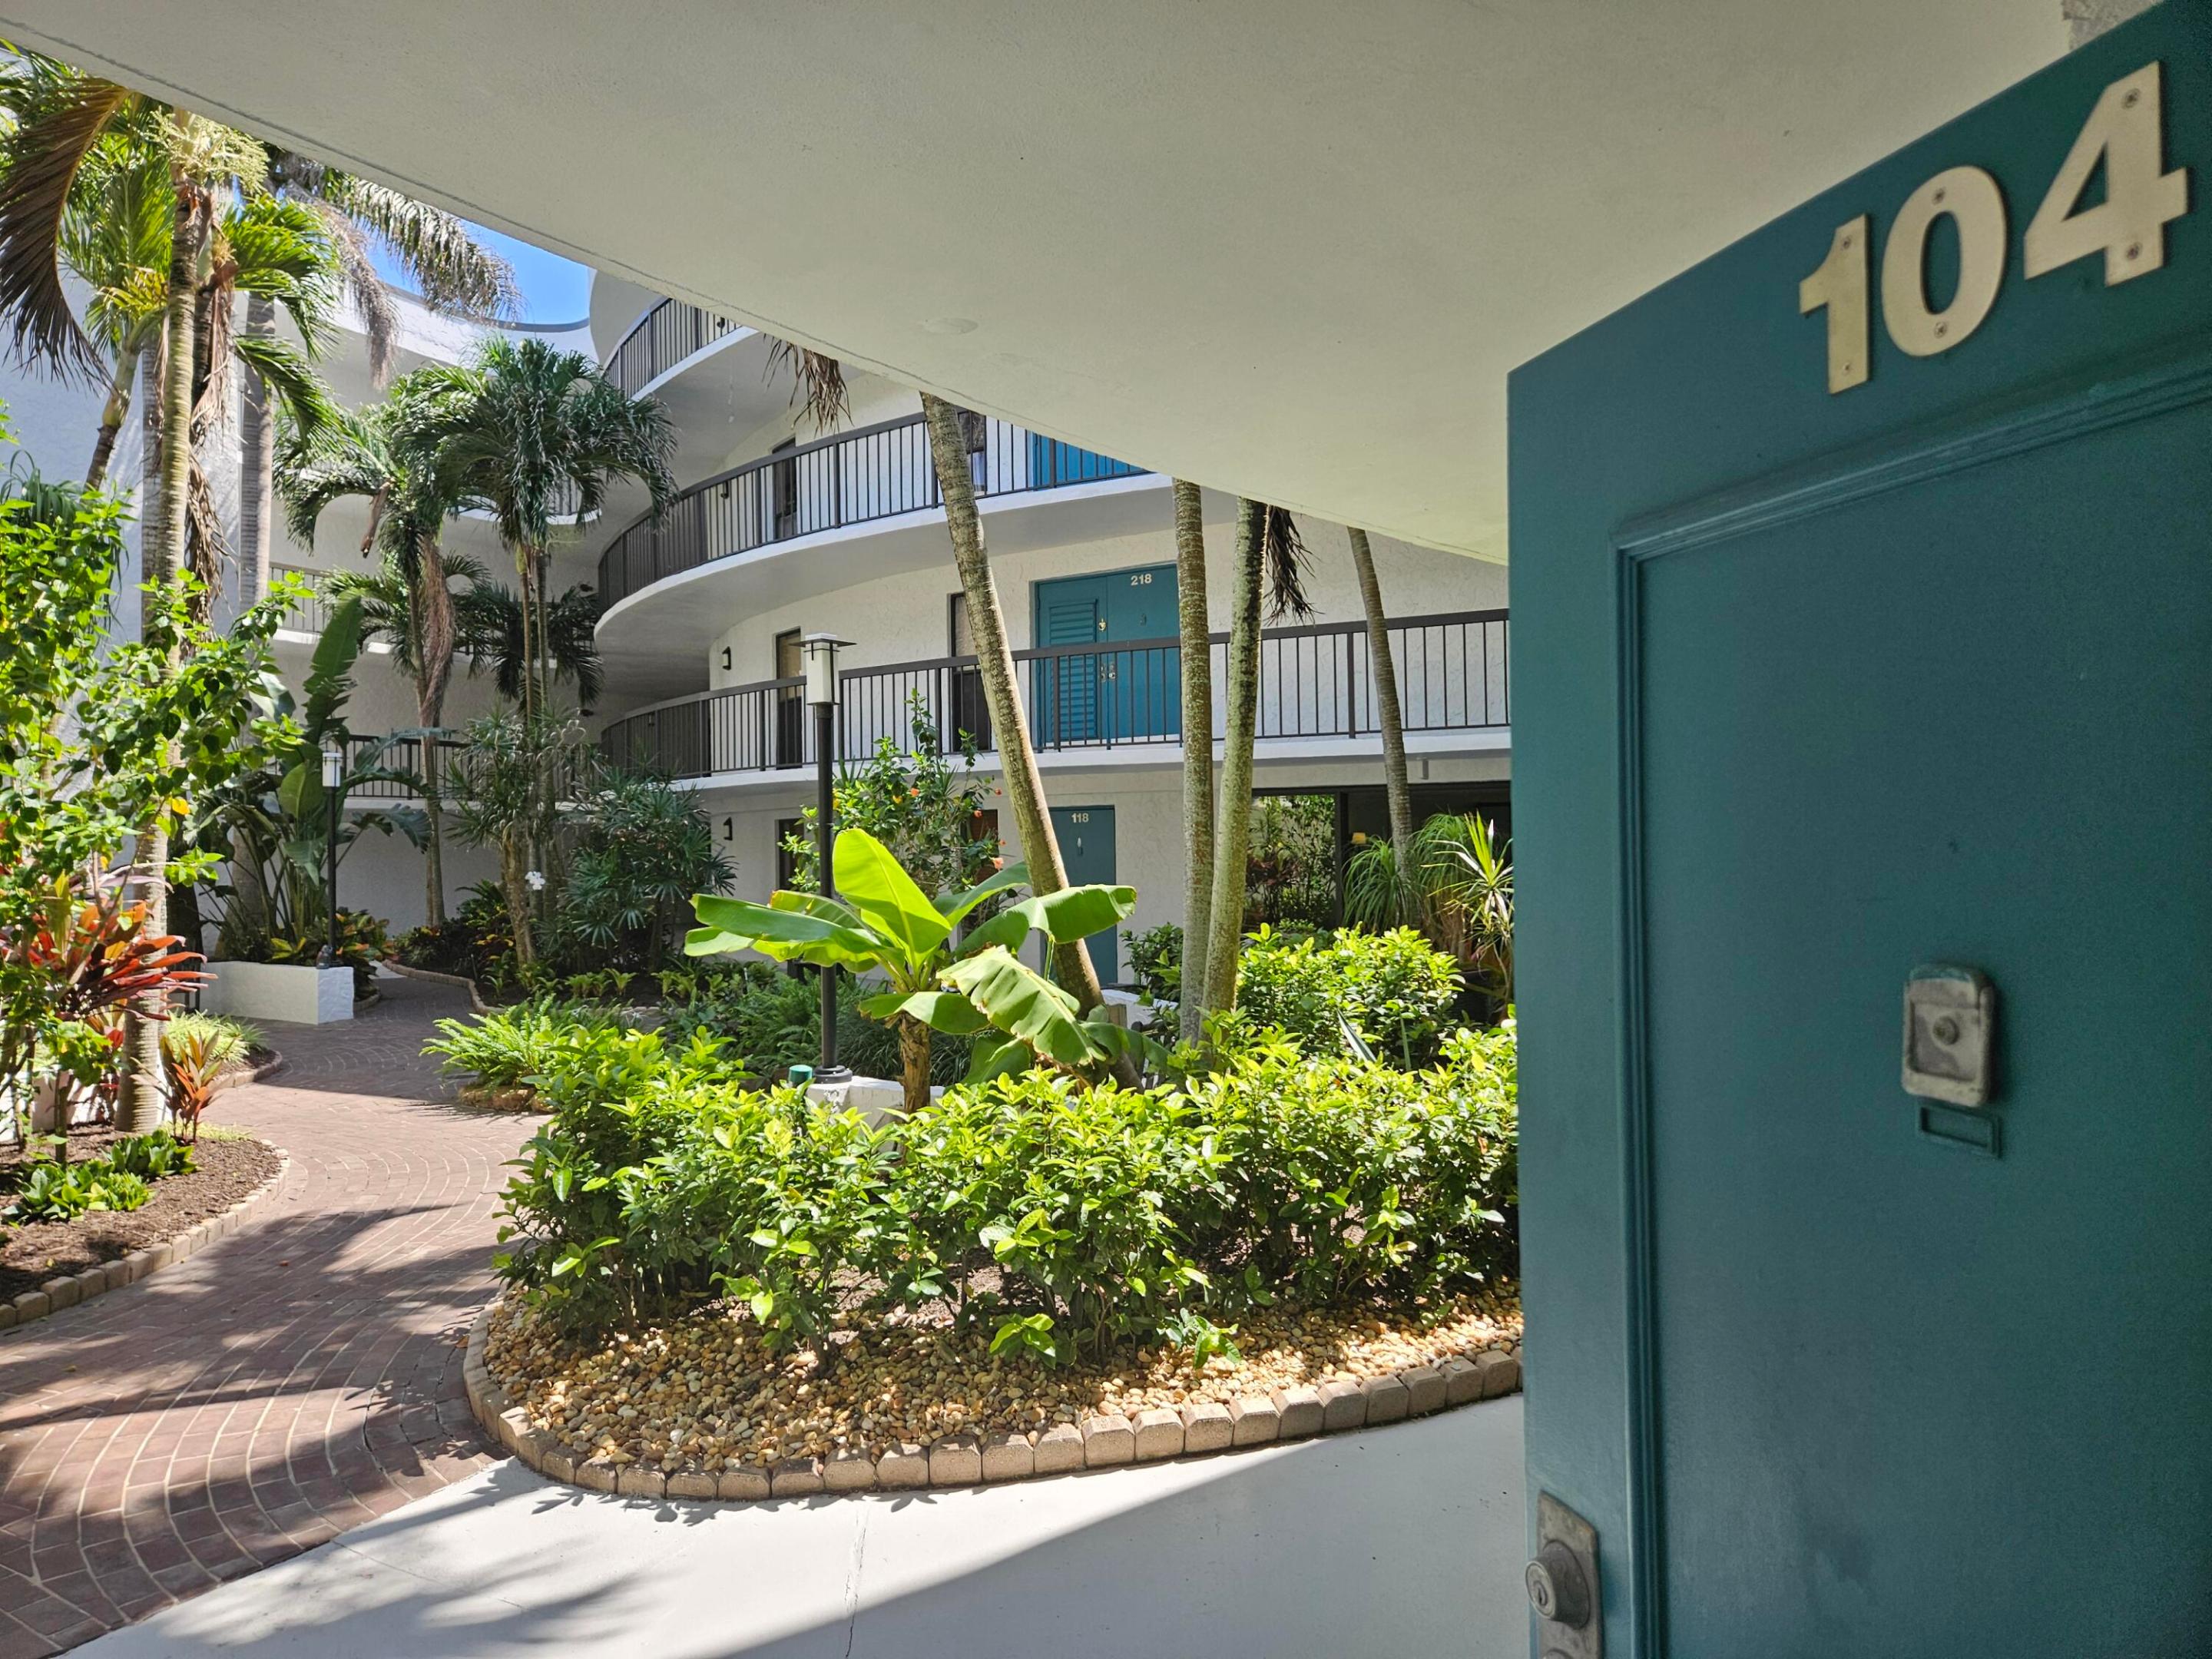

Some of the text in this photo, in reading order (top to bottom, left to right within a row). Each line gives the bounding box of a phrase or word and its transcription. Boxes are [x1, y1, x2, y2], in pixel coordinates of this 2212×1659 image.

[1799, 59, 2189, 395] 104
[1131, 573, 1152, 586] 218
[1071, 813, 1089, 823] 118
